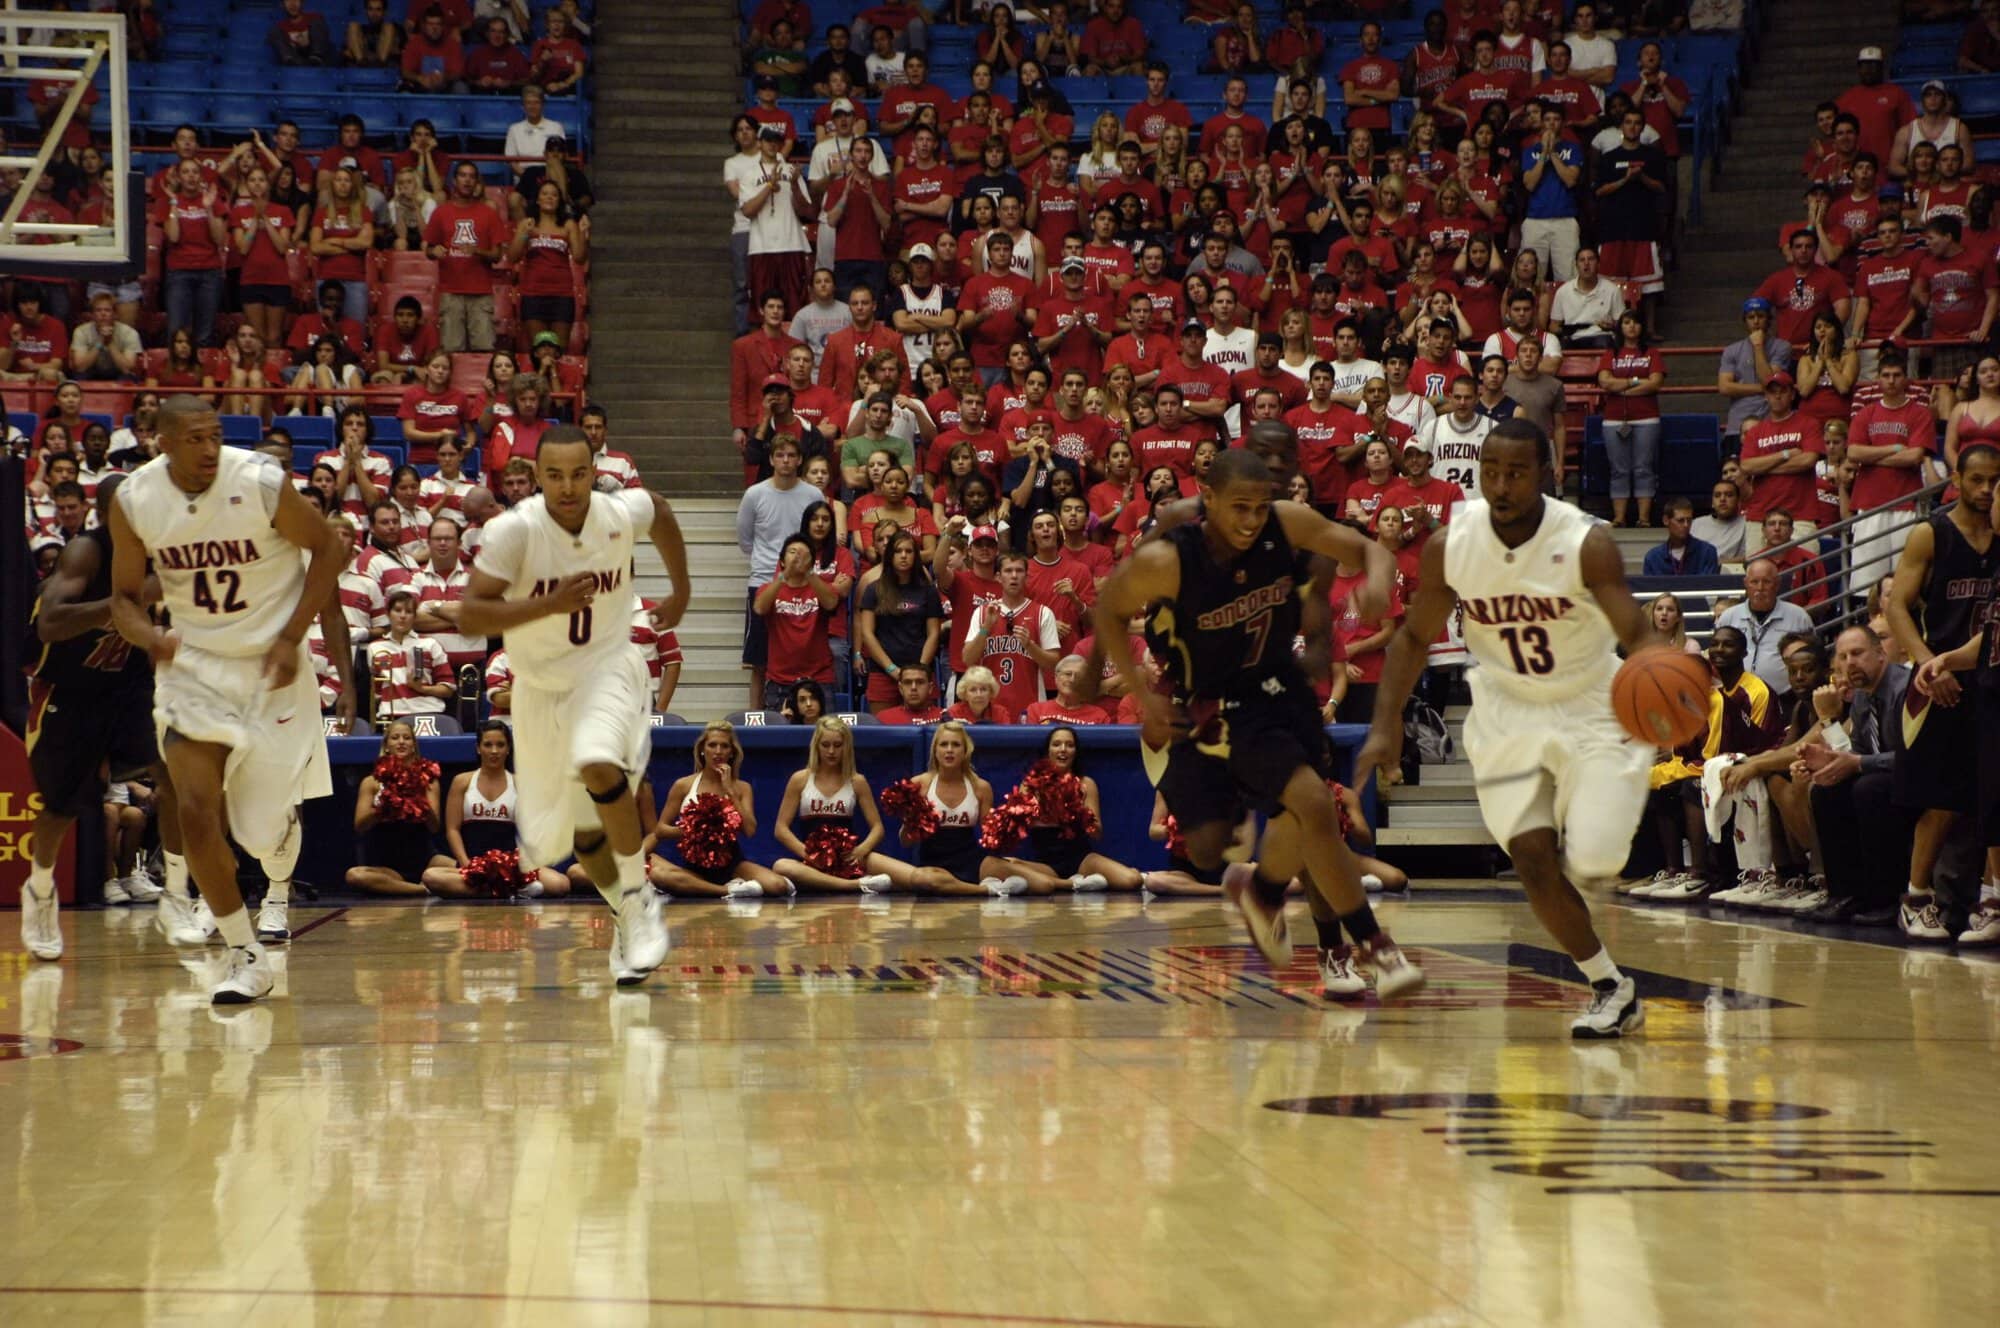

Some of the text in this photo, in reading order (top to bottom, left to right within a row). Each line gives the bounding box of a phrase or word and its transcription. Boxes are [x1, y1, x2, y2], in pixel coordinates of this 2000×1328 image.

[453, 219, 478, 245] A
[1206, 350, 1248, 365] ARIZONA
[1334, 374, 1369, 391] RIZONA
[1437, 443, 1480, 460] ARIZON
[1446, 468, 1474, 489] 24
[157, 539, 260, 570] ARIZONA
[193, 570, 248, 614] 42
[533, 568, 622, 599] ARONA
[1196, 576, 1293, 631] CONCORD
[1464, 594, 1574, 625] ARIZONA
[569, 606, 593, 645] 0
[1240, 607, 1272, 668] 7
[985, 635, 1032, 660] RIZO
[1500, 625, 1555, 675] 13
[1000, 658, 1014, 684] 3
[414, 716, 440, 736] A
